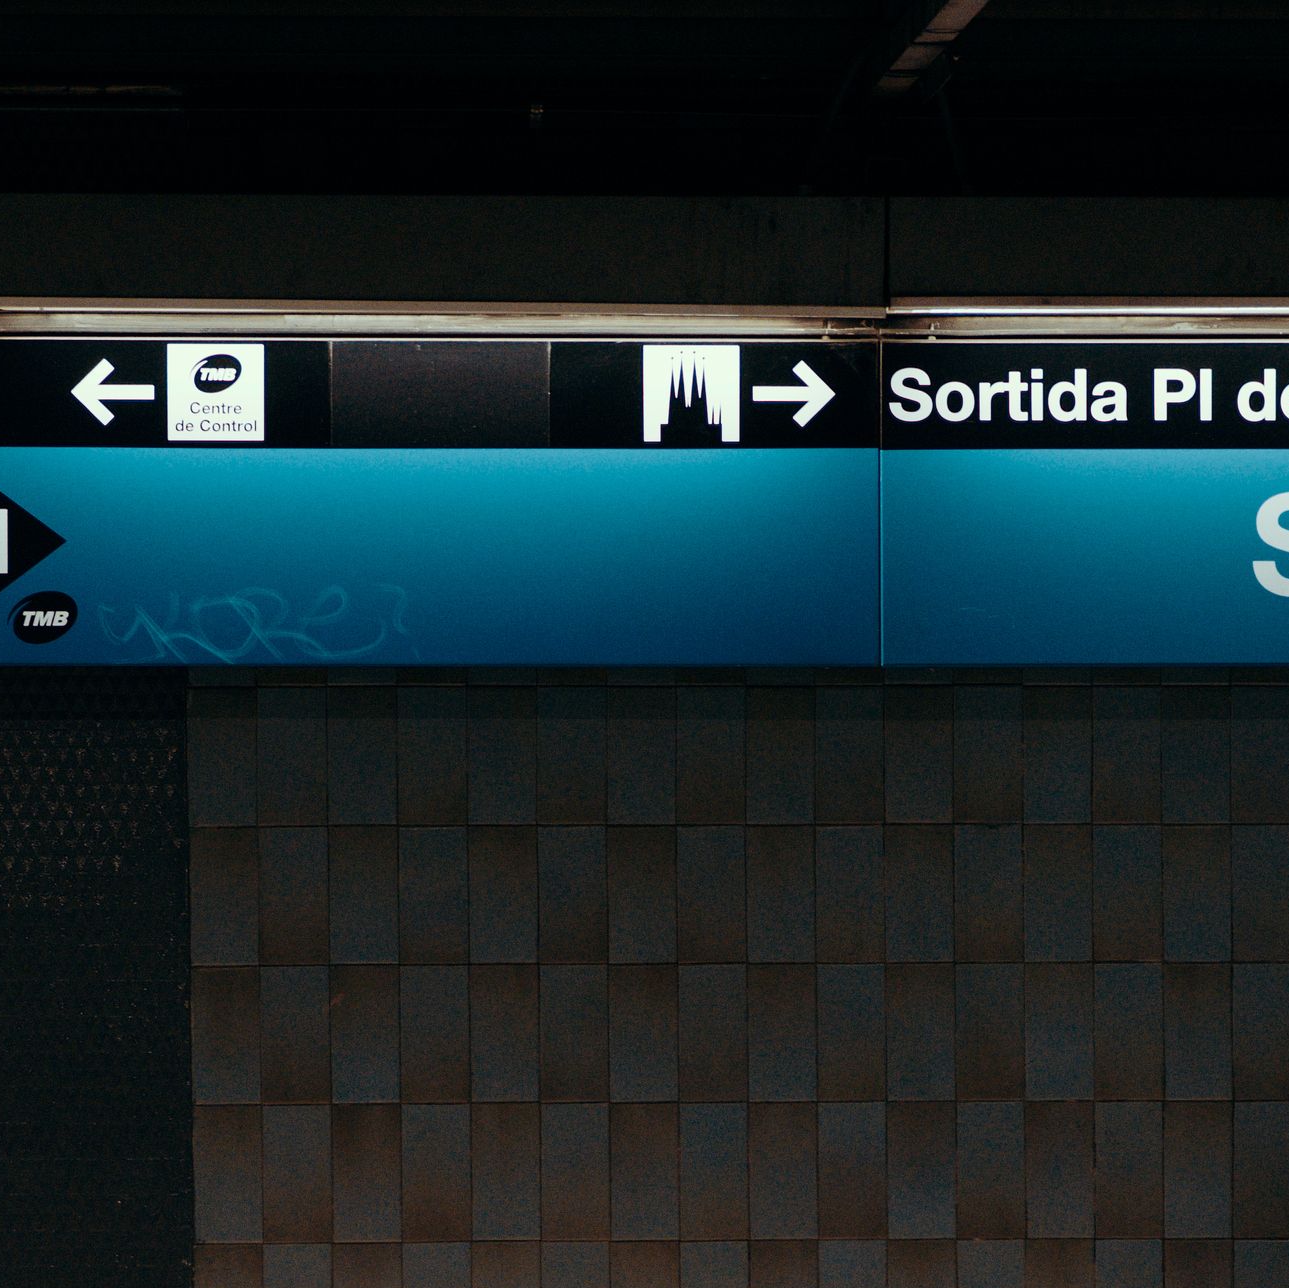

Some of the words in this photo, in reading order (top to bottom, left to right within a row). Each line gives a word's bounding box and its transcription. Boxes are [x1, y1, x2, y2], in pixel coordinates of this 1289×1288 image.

[200, 367, 237, 382] TMB
[889, 368, 1128, 421] Sortida
[1154, 369, 1212, 420] Pl
[190, 402, 242, 414] Centre
[175, 420, 194, 432] de
[200, 420, 257, 432] Control
[23, 611, 69, 626] TMB
